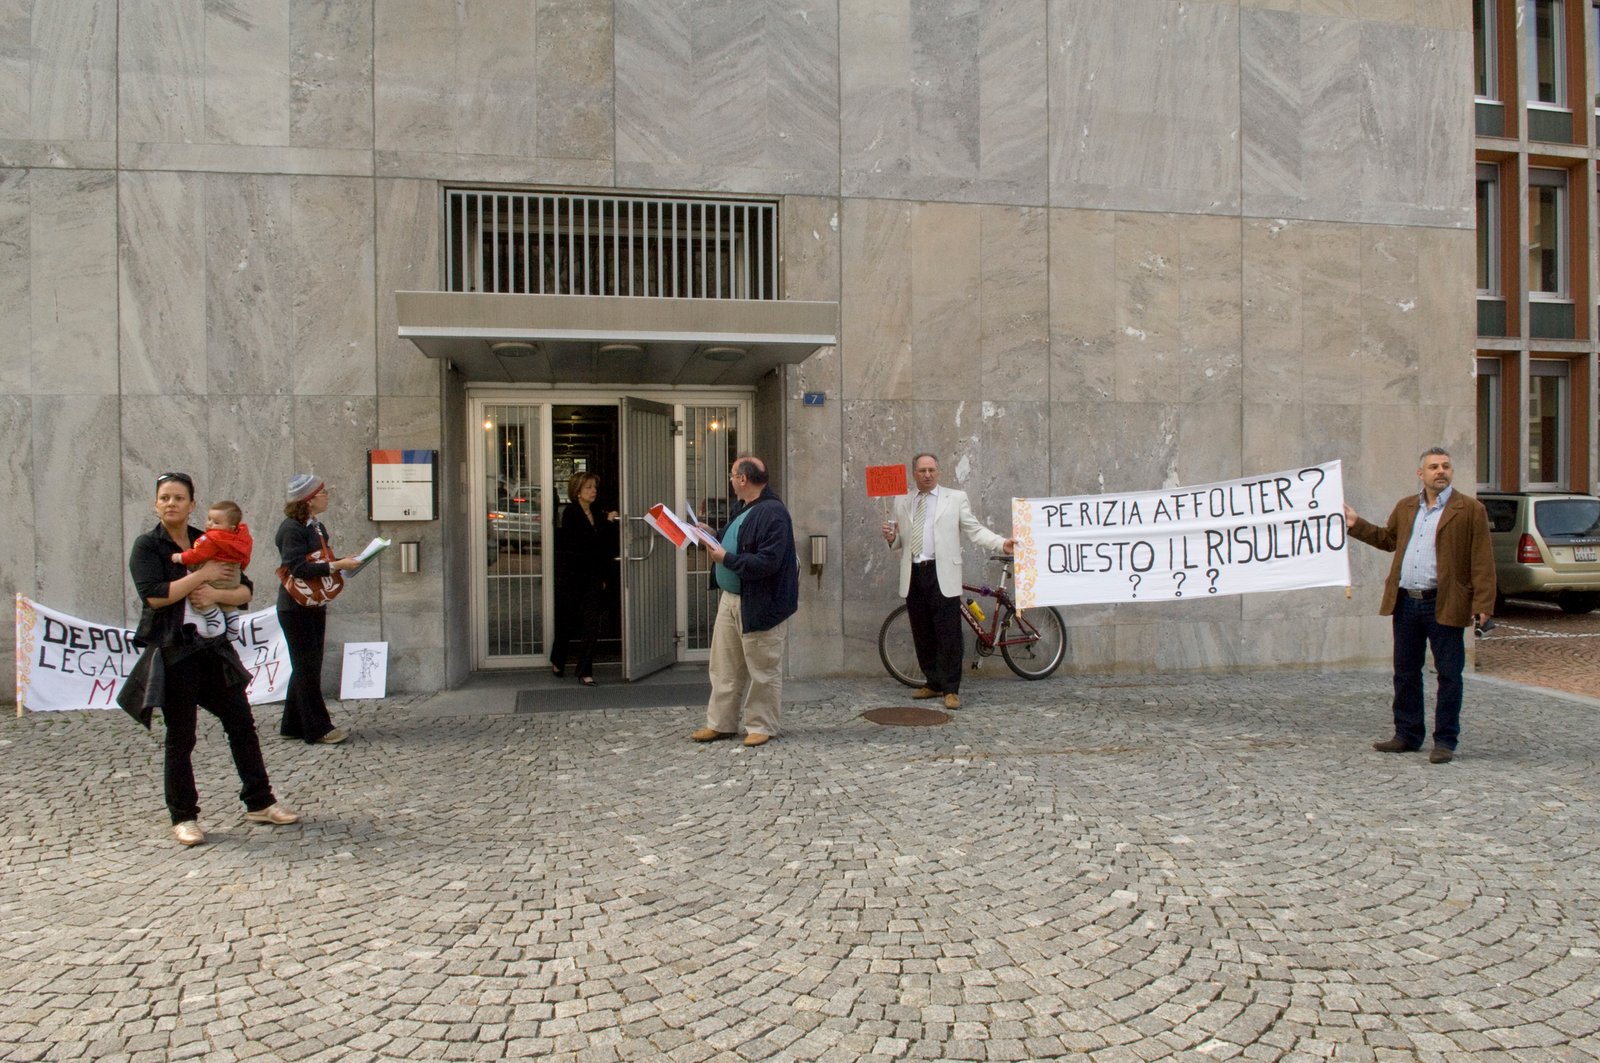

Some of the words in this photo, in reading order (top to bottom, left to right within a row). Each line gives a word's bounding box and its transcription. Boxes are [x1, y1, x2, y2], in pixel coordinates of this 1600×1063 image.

[811, 394, 818, 404] 7
[1042, 500, 1143, 528] PERIZIA
[1047, 541, 1155, 574] QUESTO
[1169, 535, 1199, 571] IL
[1204, 512, 1346, 567] RISULTATO
[253, 640, 280, 666] DI
